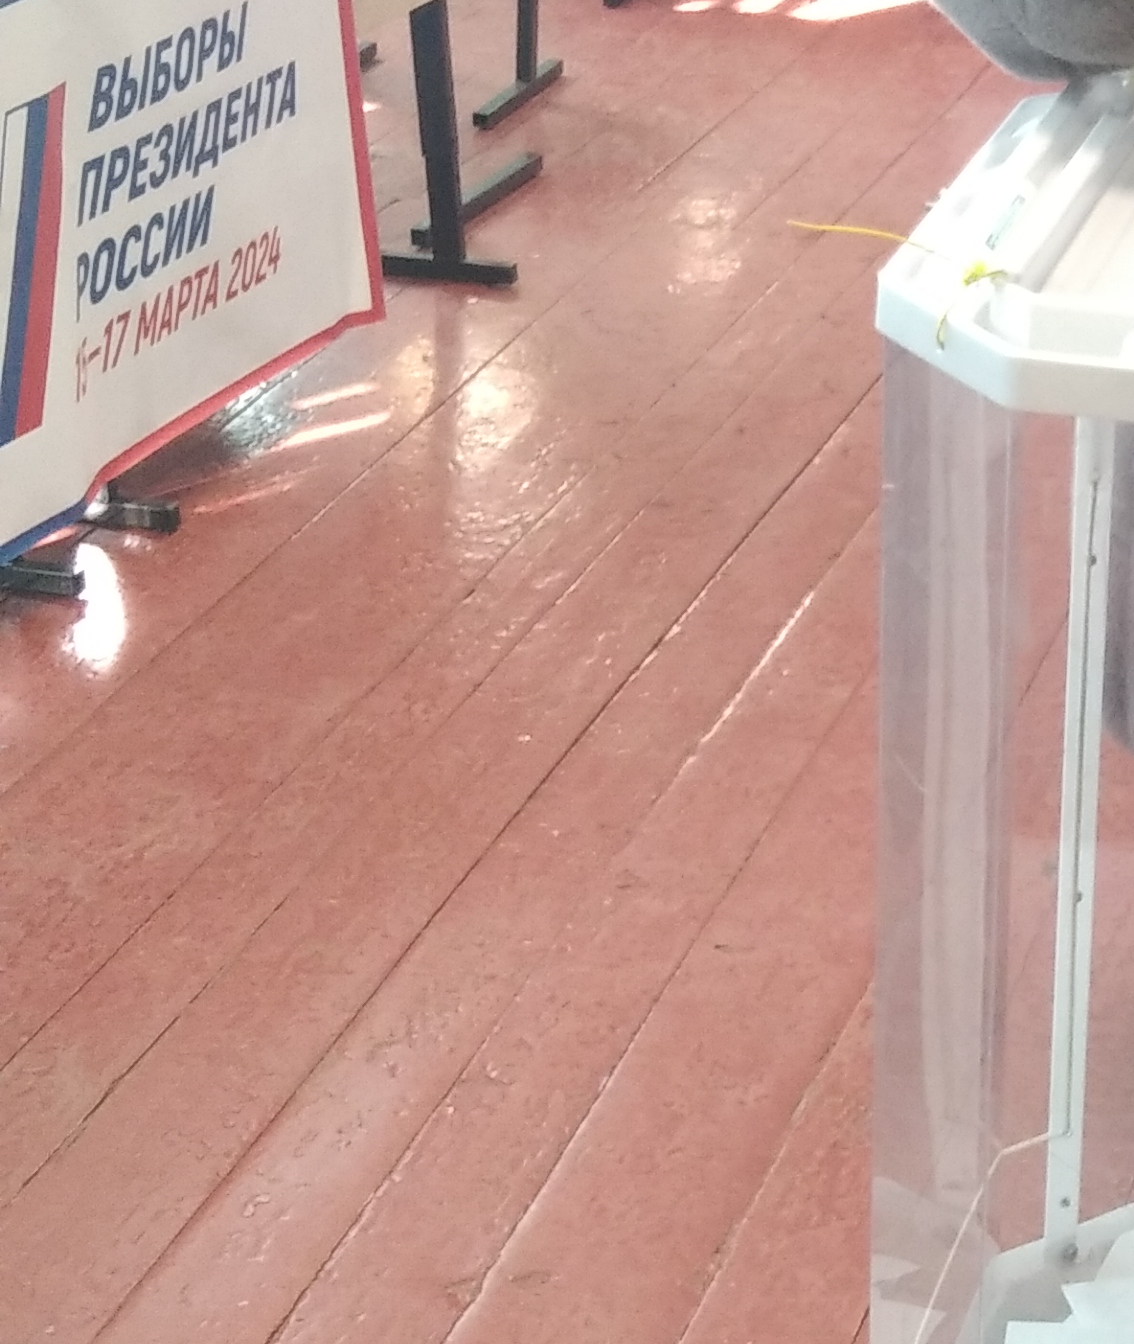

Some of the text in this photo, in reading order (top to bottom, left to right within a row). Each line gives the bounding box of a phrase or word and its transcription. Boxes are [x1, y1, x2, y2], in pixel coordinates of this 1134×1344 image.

[88, 1, 248, 133] ВЫБОРЫ
[77, 60, 296, 227] ПРЕЗИДЕНТА
[76, 184, 215, 323] РОССИИ
[133, 259, 219, 356] МАРТА
[225, 225, 281, 302] 2024
